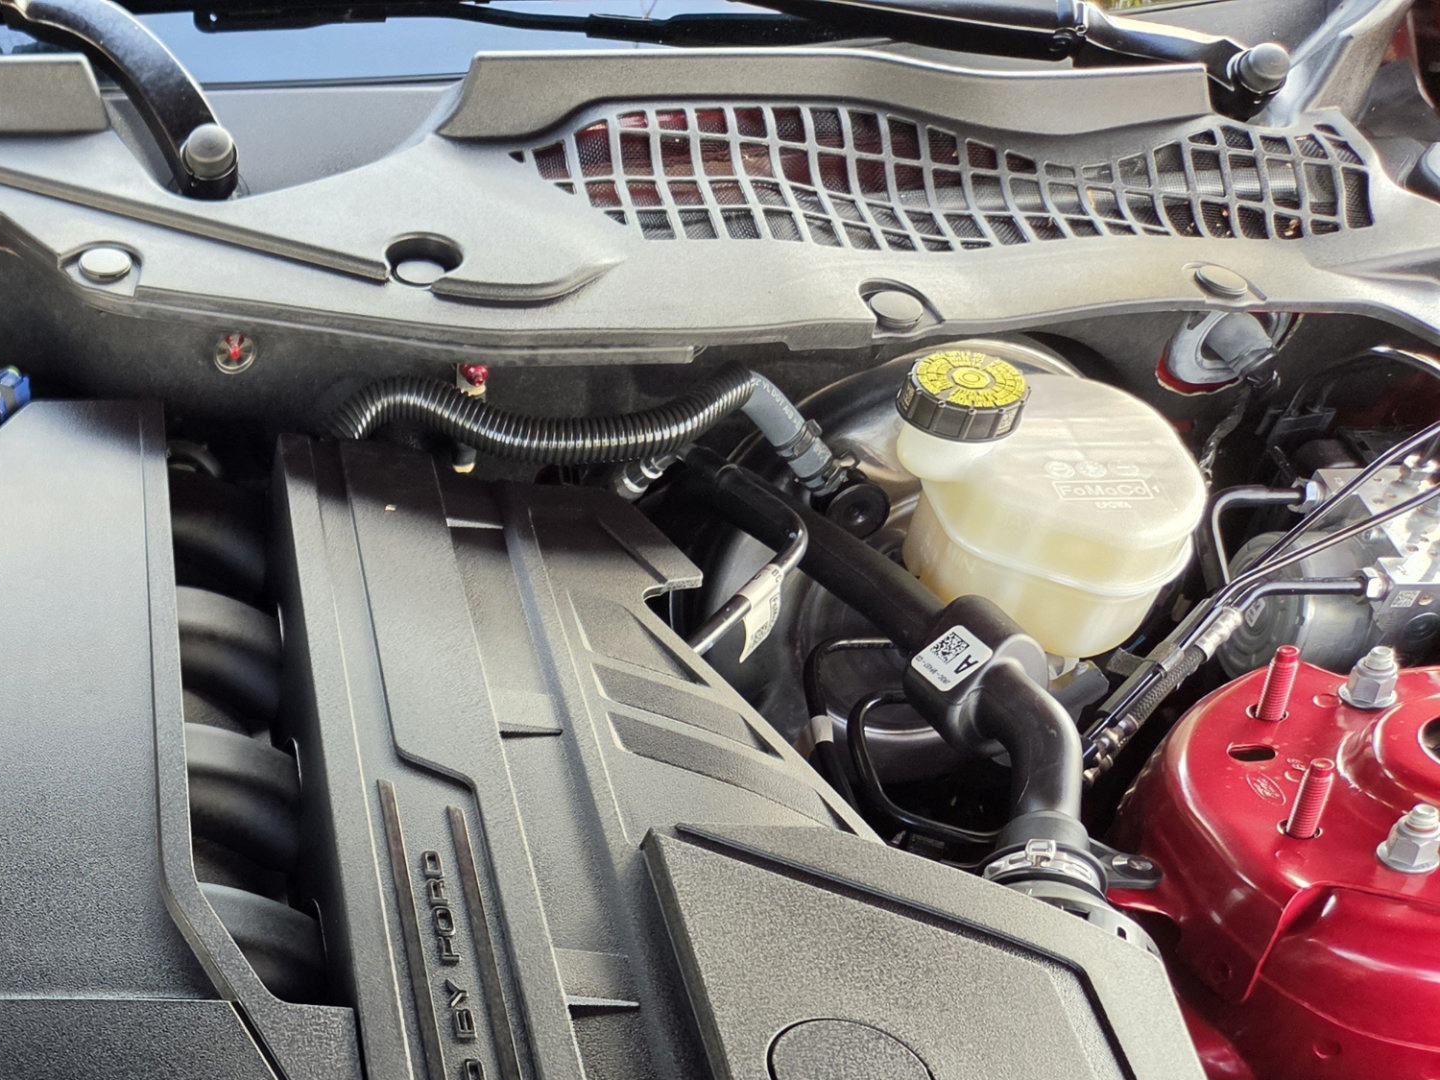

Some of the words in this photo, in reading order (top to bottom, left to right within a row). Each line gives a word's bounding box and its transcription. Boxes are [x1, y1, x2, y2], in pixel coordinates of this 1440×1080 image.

[954, 654, 979, 675] A
[421, 849, 461, 967] FORD
[445, 978, 478, 1041] BY
